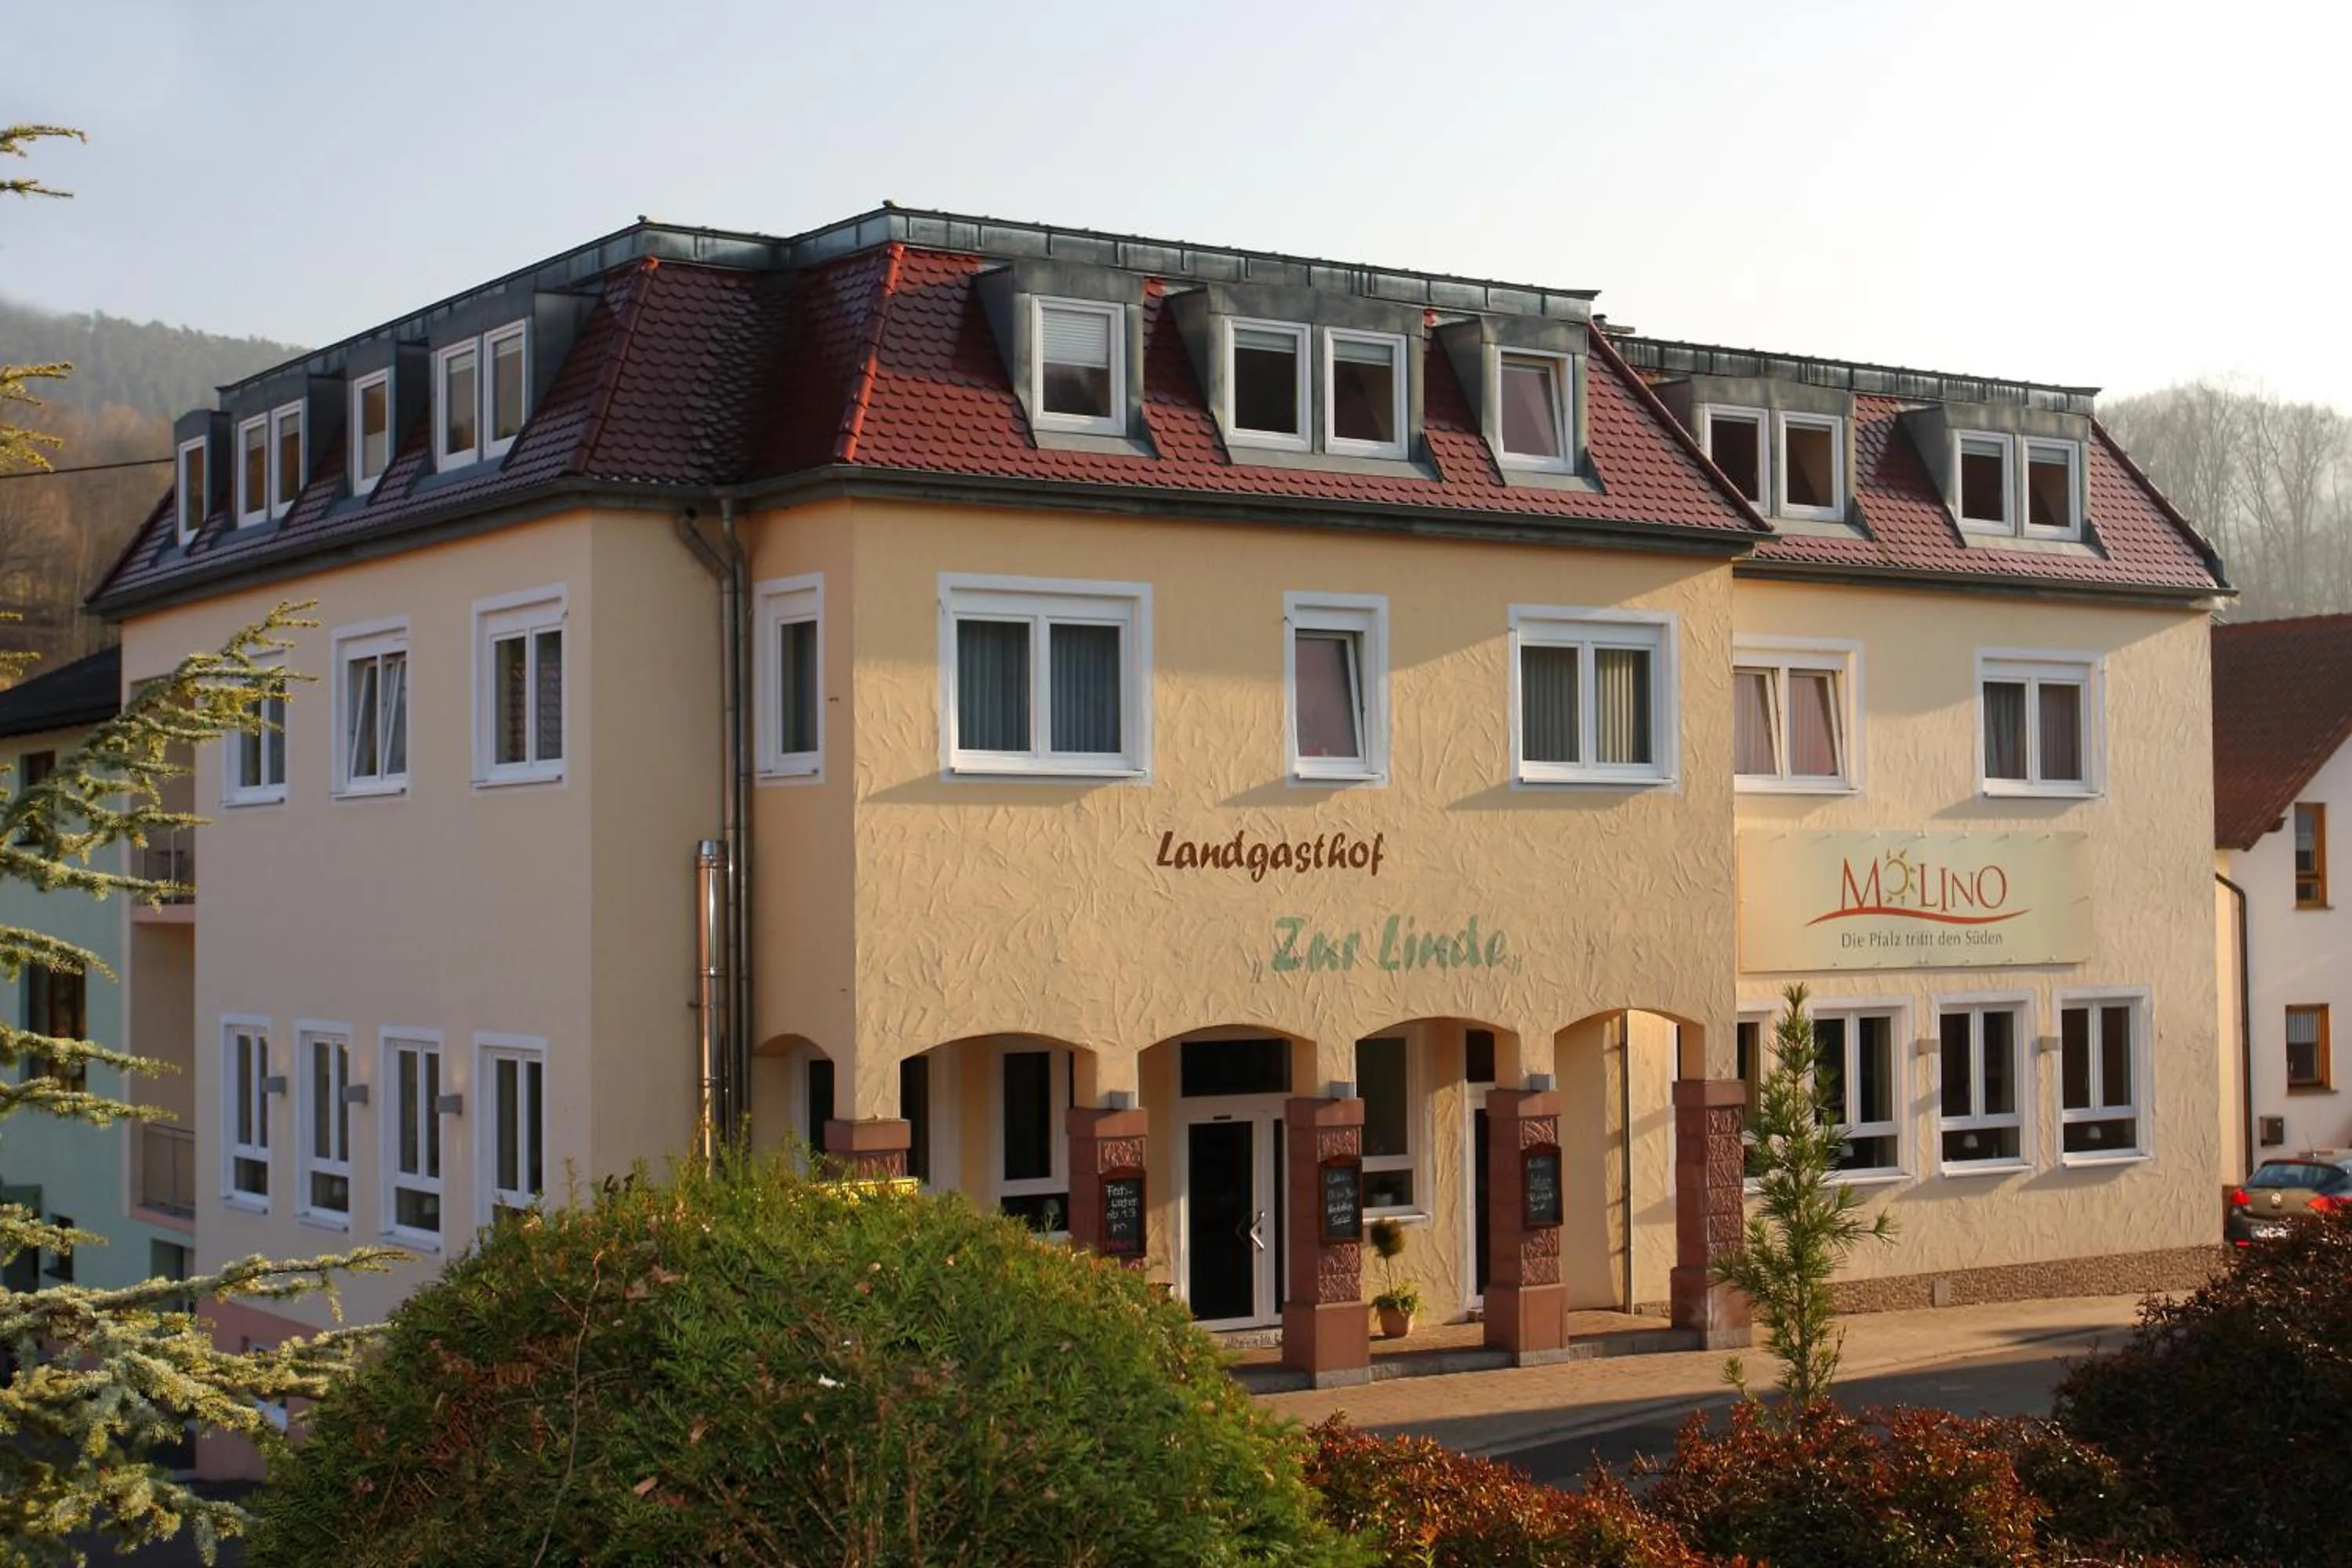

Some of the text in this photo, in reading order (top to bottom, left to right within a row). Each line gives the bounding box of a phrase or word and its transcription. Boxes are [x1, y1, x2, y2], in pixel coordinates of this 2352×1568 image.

[1156, 829, 1385, 883] Landgasthof
[1840, 855, 2008, 913] MOLINO
[1270, 913, 1507, 974] Zur Linde
[1841, 928, 2004, 949] Die Pfalz trifft den Süden
